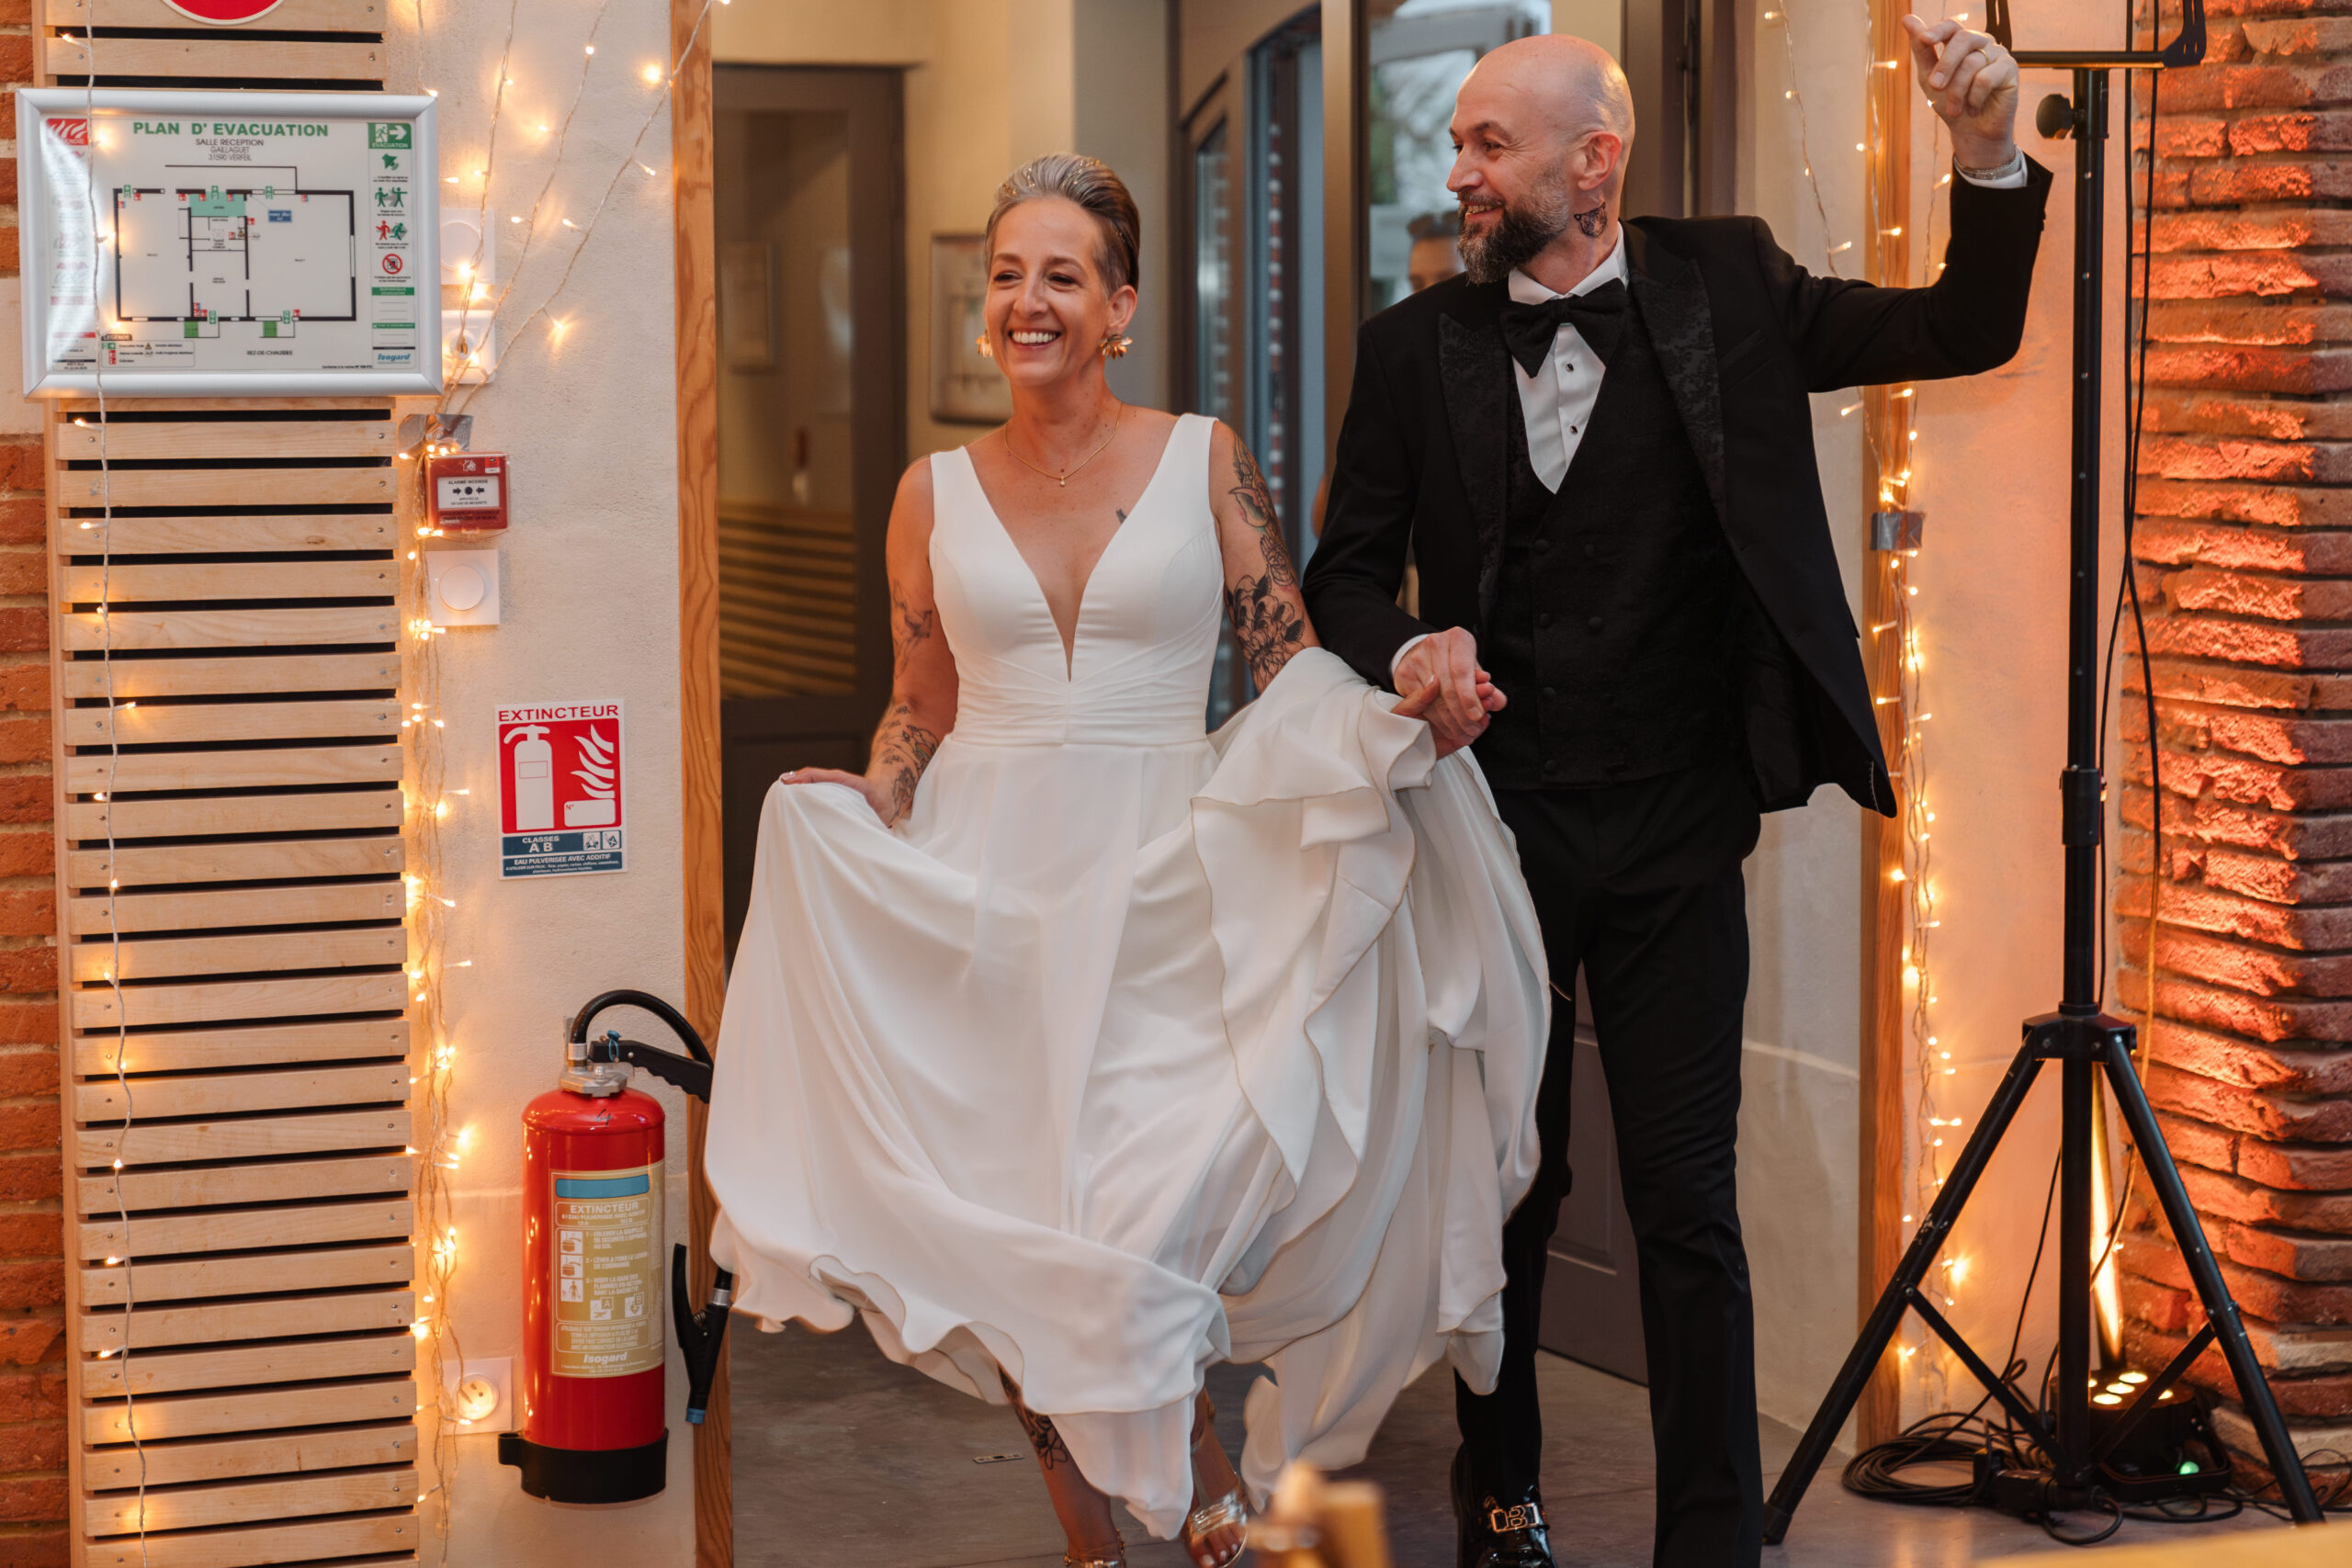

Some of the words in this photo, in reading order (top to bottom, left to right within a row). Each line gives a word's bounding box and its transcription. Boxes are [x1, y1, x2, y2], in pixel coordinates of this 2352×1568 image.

[133, 122, 179, 134] PLAN
[191, 123, 208, 135] D'
[213, 123, 329, 137] EVACUATION
[378, 353, 411, 361] Isogard
[498, 705, 619, 722] EXTINCTEUR
[528, 842, 539, 853] A
[543, 841, 553, 852] B
[595, 1108, 616, 1127] 4
[571, 1201, 639, 1213] EXTINCTEUR
[583, 1351, 628, 1364] Isogard
